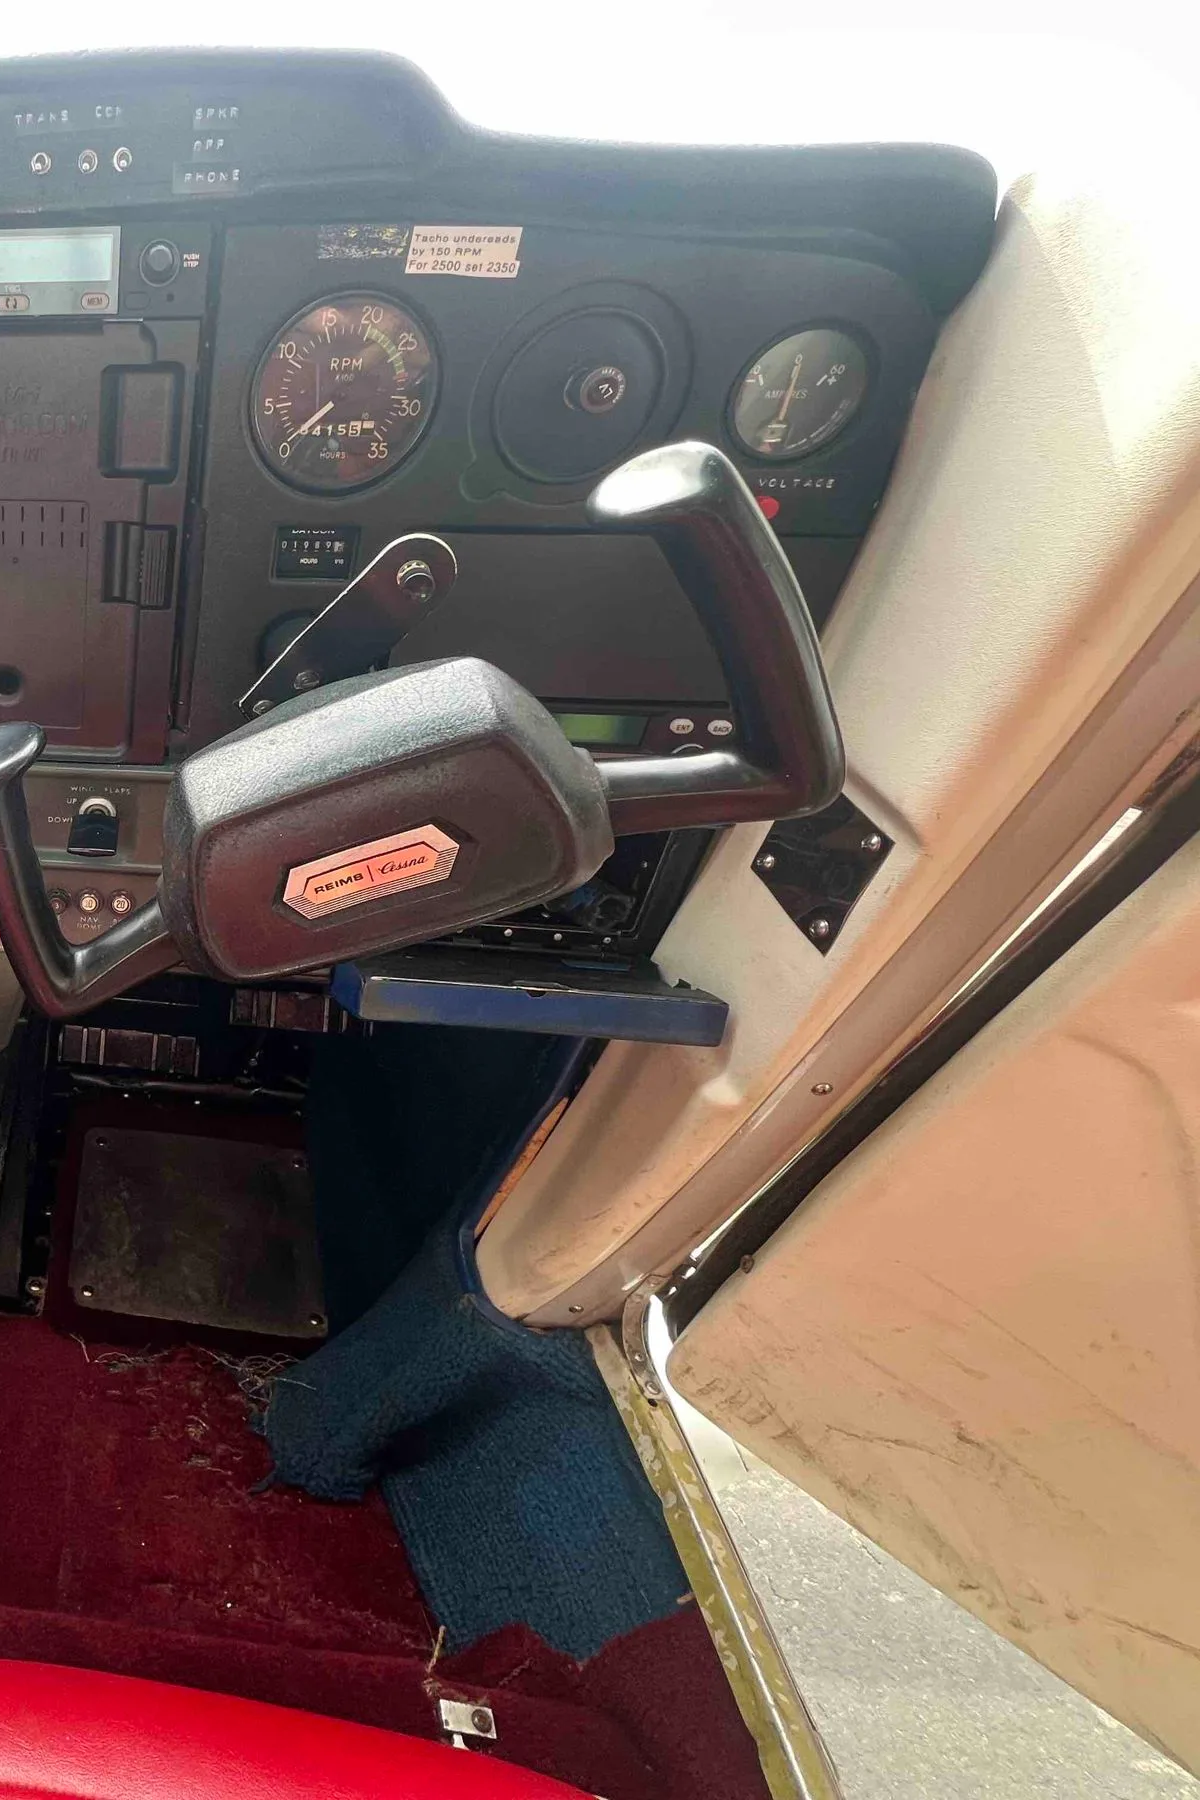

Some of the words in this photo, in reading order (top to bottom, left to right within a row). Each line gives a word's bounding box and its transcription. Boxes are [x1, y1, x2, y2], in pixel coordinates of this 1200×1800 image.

[14, 109, 69, 126] TRANS
[194, 106, 240, 120] SPKR
[184, 168, 241, 184] PHONE
[414, 233, 450, 244] Tacho
[452, 233, 517, 245] undereads
[183, 253, 200, 261] PUSH
[411, 246, 425, 257] by
[429, 246, 452, 257] 150
[454, 247, 483, 257] RPM
[183, 260, 199, 268] STEP
[407, 259, 429, 271] For
[430, 259, 462, 272] 2500
[464, 262, 483, 273] set
[486, 261, 517, 274] 2350
[321, 308, 338, 327] 15
[360, 305, 384, 325] 20
[398, 332, 418, 352] 25
[278, 341, 298, 360] 10
[330, 357, 364, 371] RPM
[795, 352, 803, 365] 0
[829, 363, 846, 376] 60
[263, 397, 275, 415] 5
[398, 399, 422, 416] 30
[278, 441, 291, 459] 0
[319, 451, 347, 460] HOURS
[367, 442, 389, 460] 35
[675, 723, 691, 732] ENT
[66, 797, 78, 805] UP
[314, 872, 365, 895] REIMS
[377, 854, 430, 877] Cessna
[115, 898, 127, 909] 20
[79, 915, 100, 924] NAV
